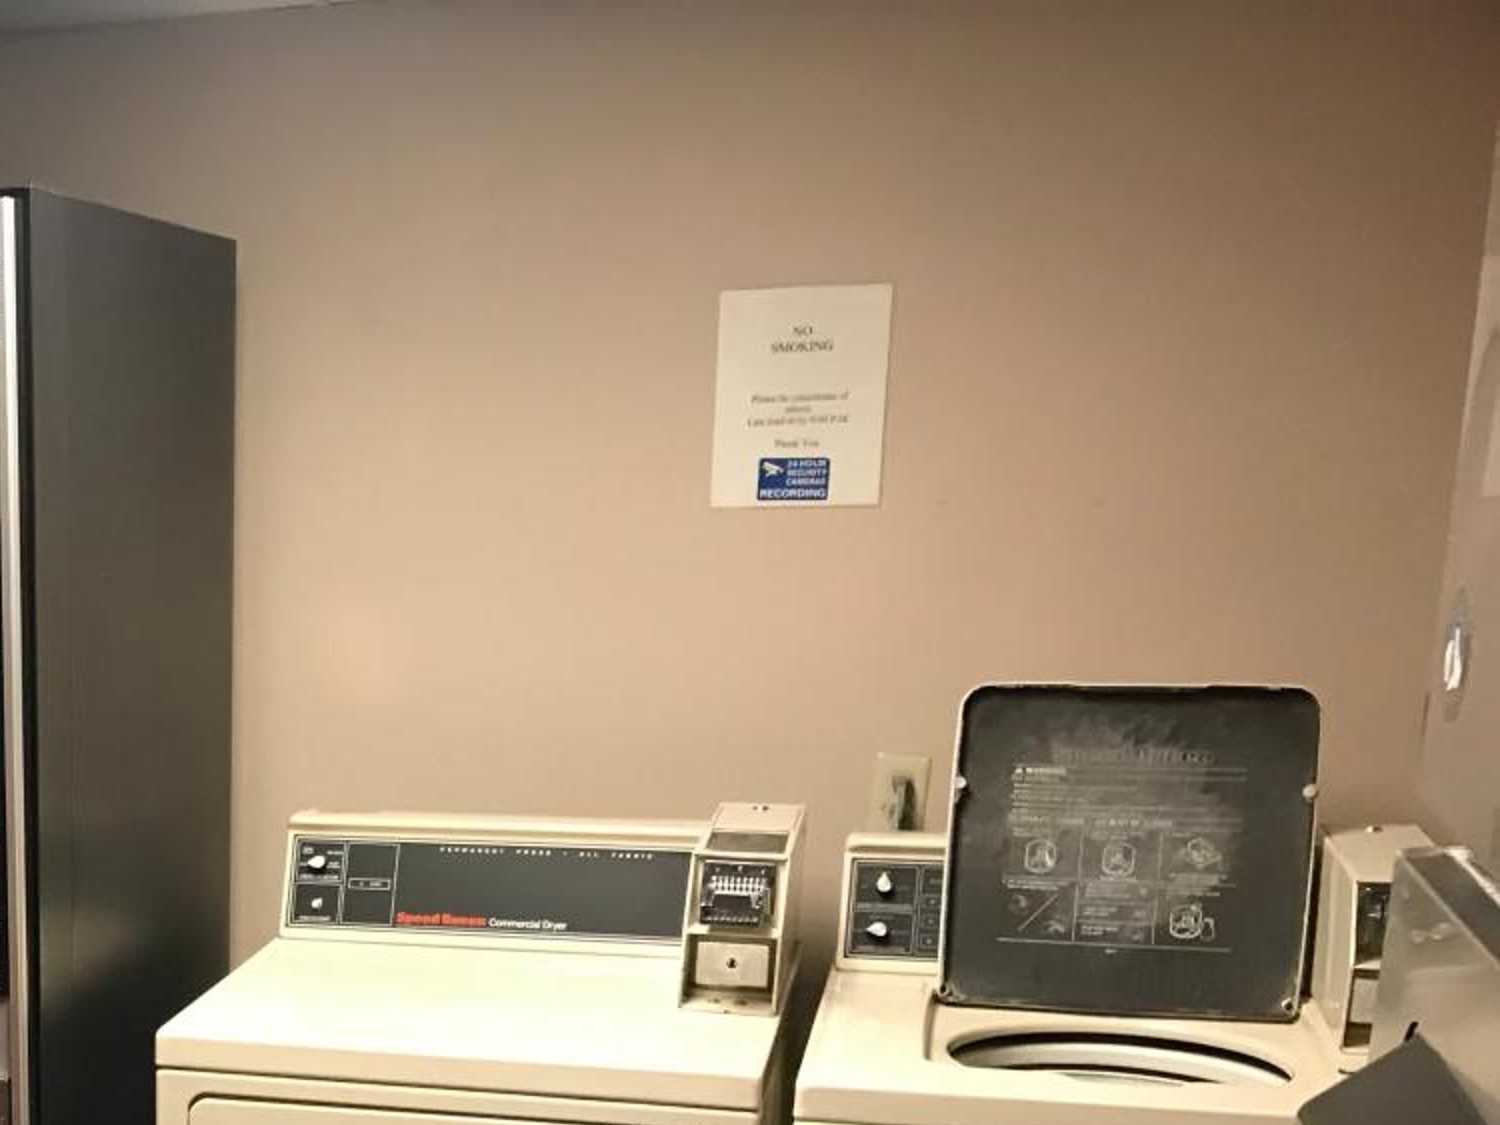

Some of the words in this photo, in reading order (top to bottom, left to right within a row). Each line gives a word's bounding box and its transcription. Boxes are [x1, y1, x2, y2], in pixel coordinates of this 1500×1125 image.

[760, 488, 826, 498] RECORDING
[397, 911, 441, 925] Speed
[488, 917, 542, 930] Commercial
[542, 919, 568, 933] Dryer
